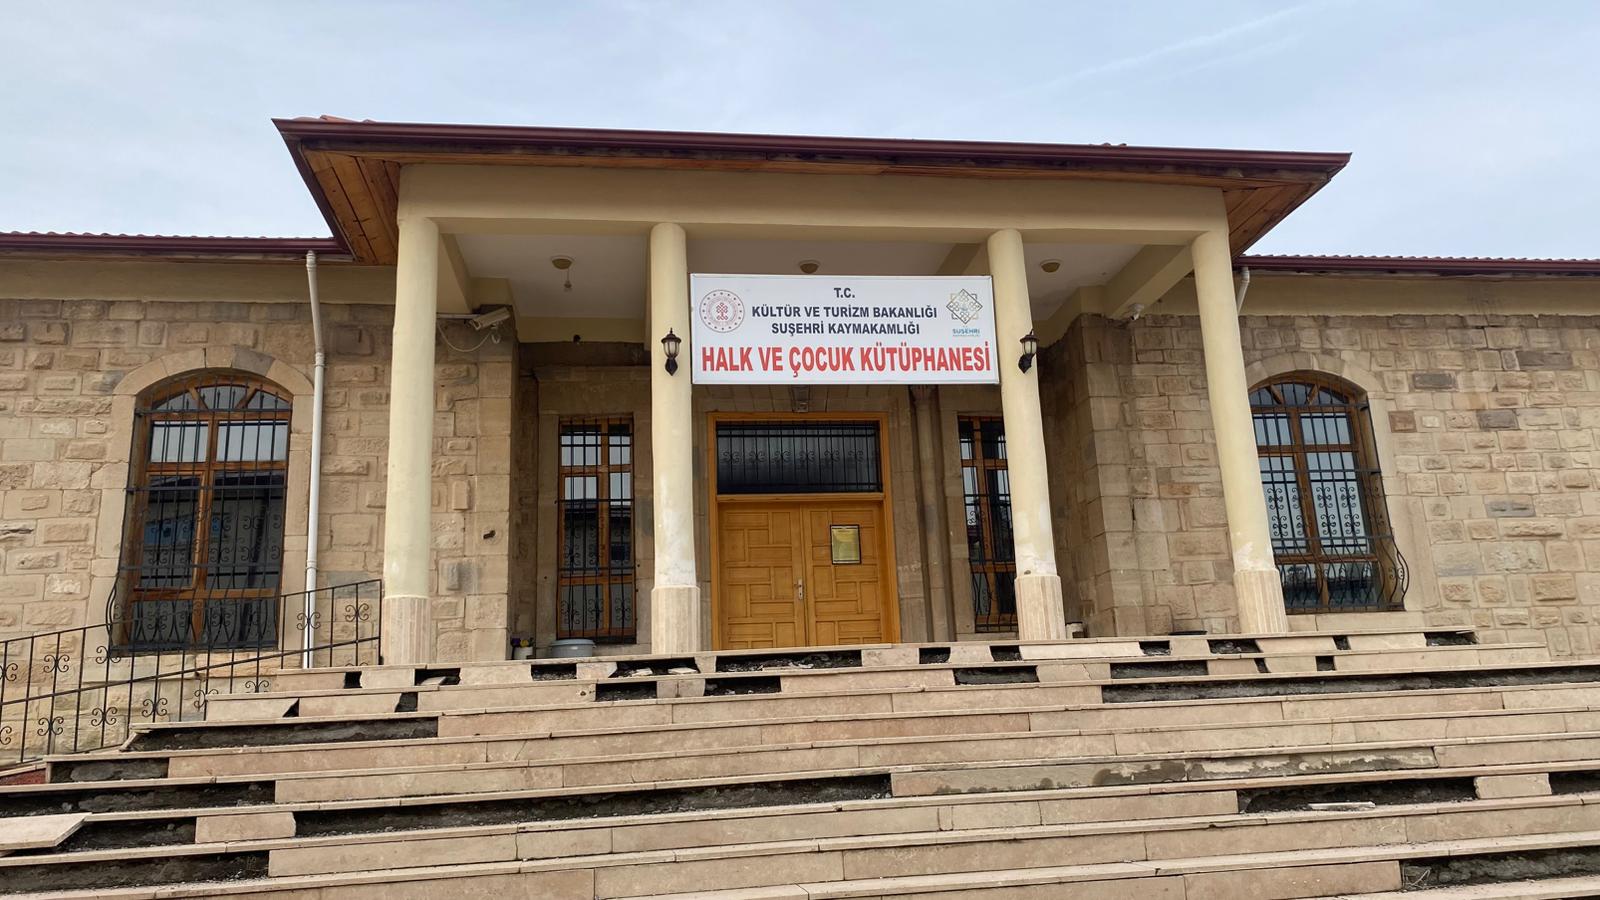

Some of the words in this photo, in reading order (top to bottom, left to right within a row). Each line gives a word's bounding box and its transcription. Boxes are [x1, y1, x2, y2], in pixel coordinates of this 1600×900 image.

[834, 288, 855, 298] T.C.
[752, 304, 801, 317] KÜLTÜR
[804, 307, 820, 317] VE
[824, 305, 870, 317] TURİZM
[873, 304, 937, 318] BAKANLIĞI
[772, 321, 824, 336] SUŞEHRİ
[829, 321, 920, 334] KAYMAKAMLIĞI
[702, 347, 753, 371] HALK
[758, 347, 783, 371] VE
[789, 347, 855, 377] ÇOCUK
[860, 341, 991, 372] KÜTÜPHANESİ
